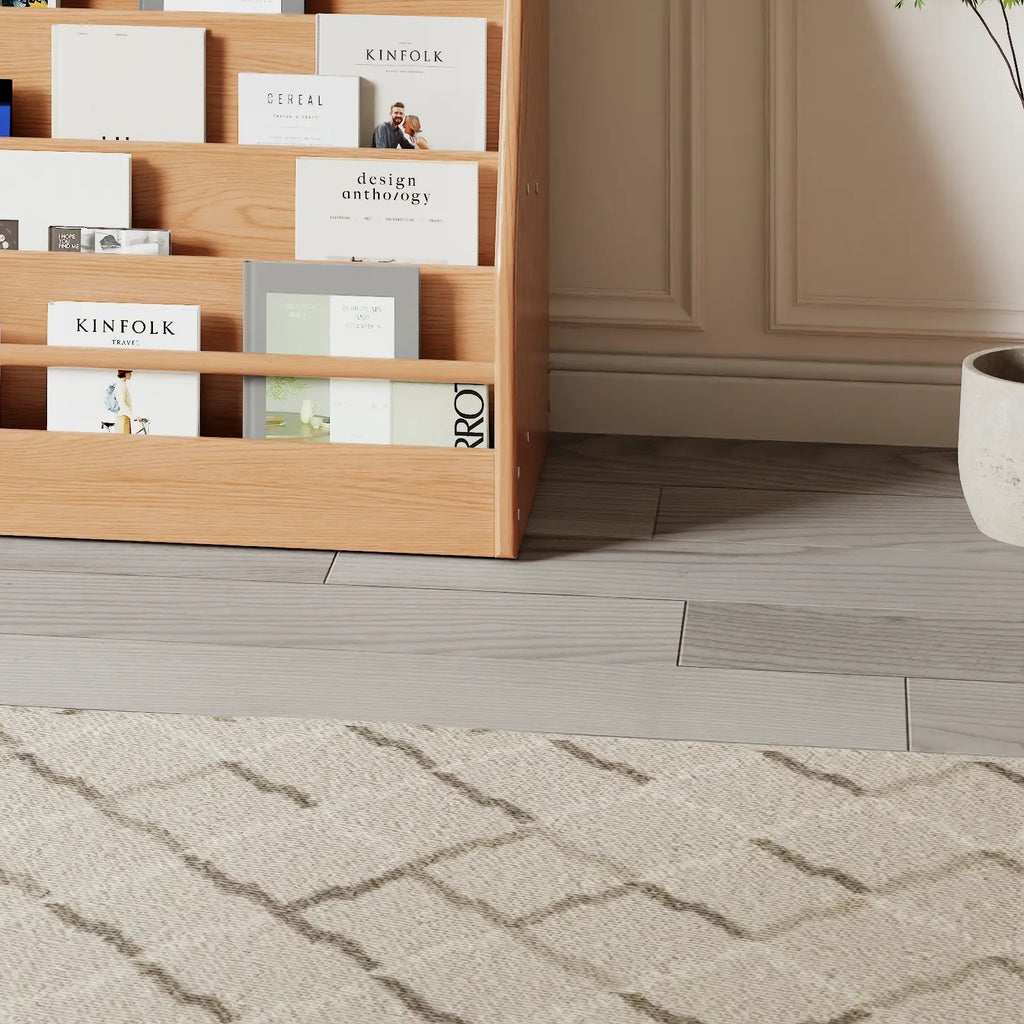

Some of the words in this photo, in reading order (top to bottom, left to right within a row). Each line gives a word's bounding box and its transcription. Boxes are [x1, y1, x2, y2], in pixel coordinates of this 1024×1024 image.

[365, 48, 444, 63] KINFOLK
[267, 92, 323, 106] CEREAL
[357, 172, 417, 190] design
[76, 318, 176, 336] KINFOLK
